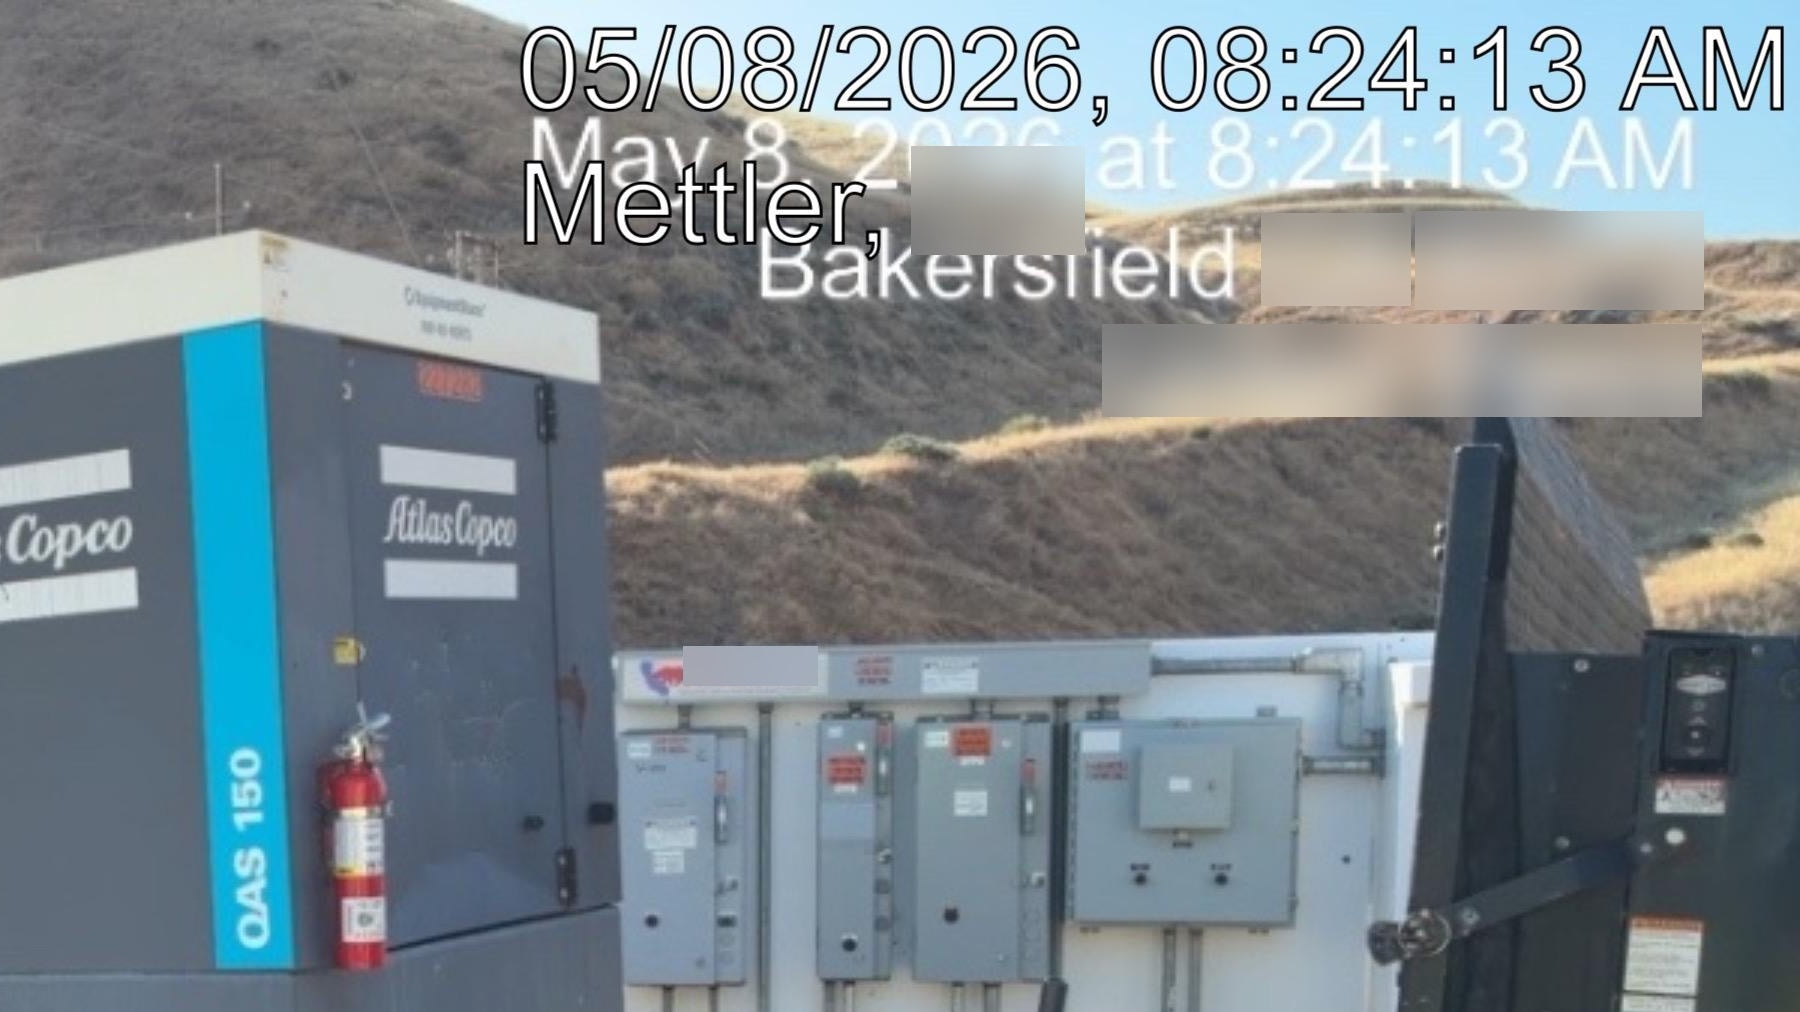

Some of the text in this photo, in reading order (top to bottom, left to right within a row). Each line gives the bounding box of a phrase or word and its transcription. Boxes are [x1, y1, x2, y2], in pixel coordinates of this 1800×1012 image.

[5, 513, 134, 571] Copco
[383, 494, 518, 557] Atlas Copco
[229, 746, 264, 833] 150
